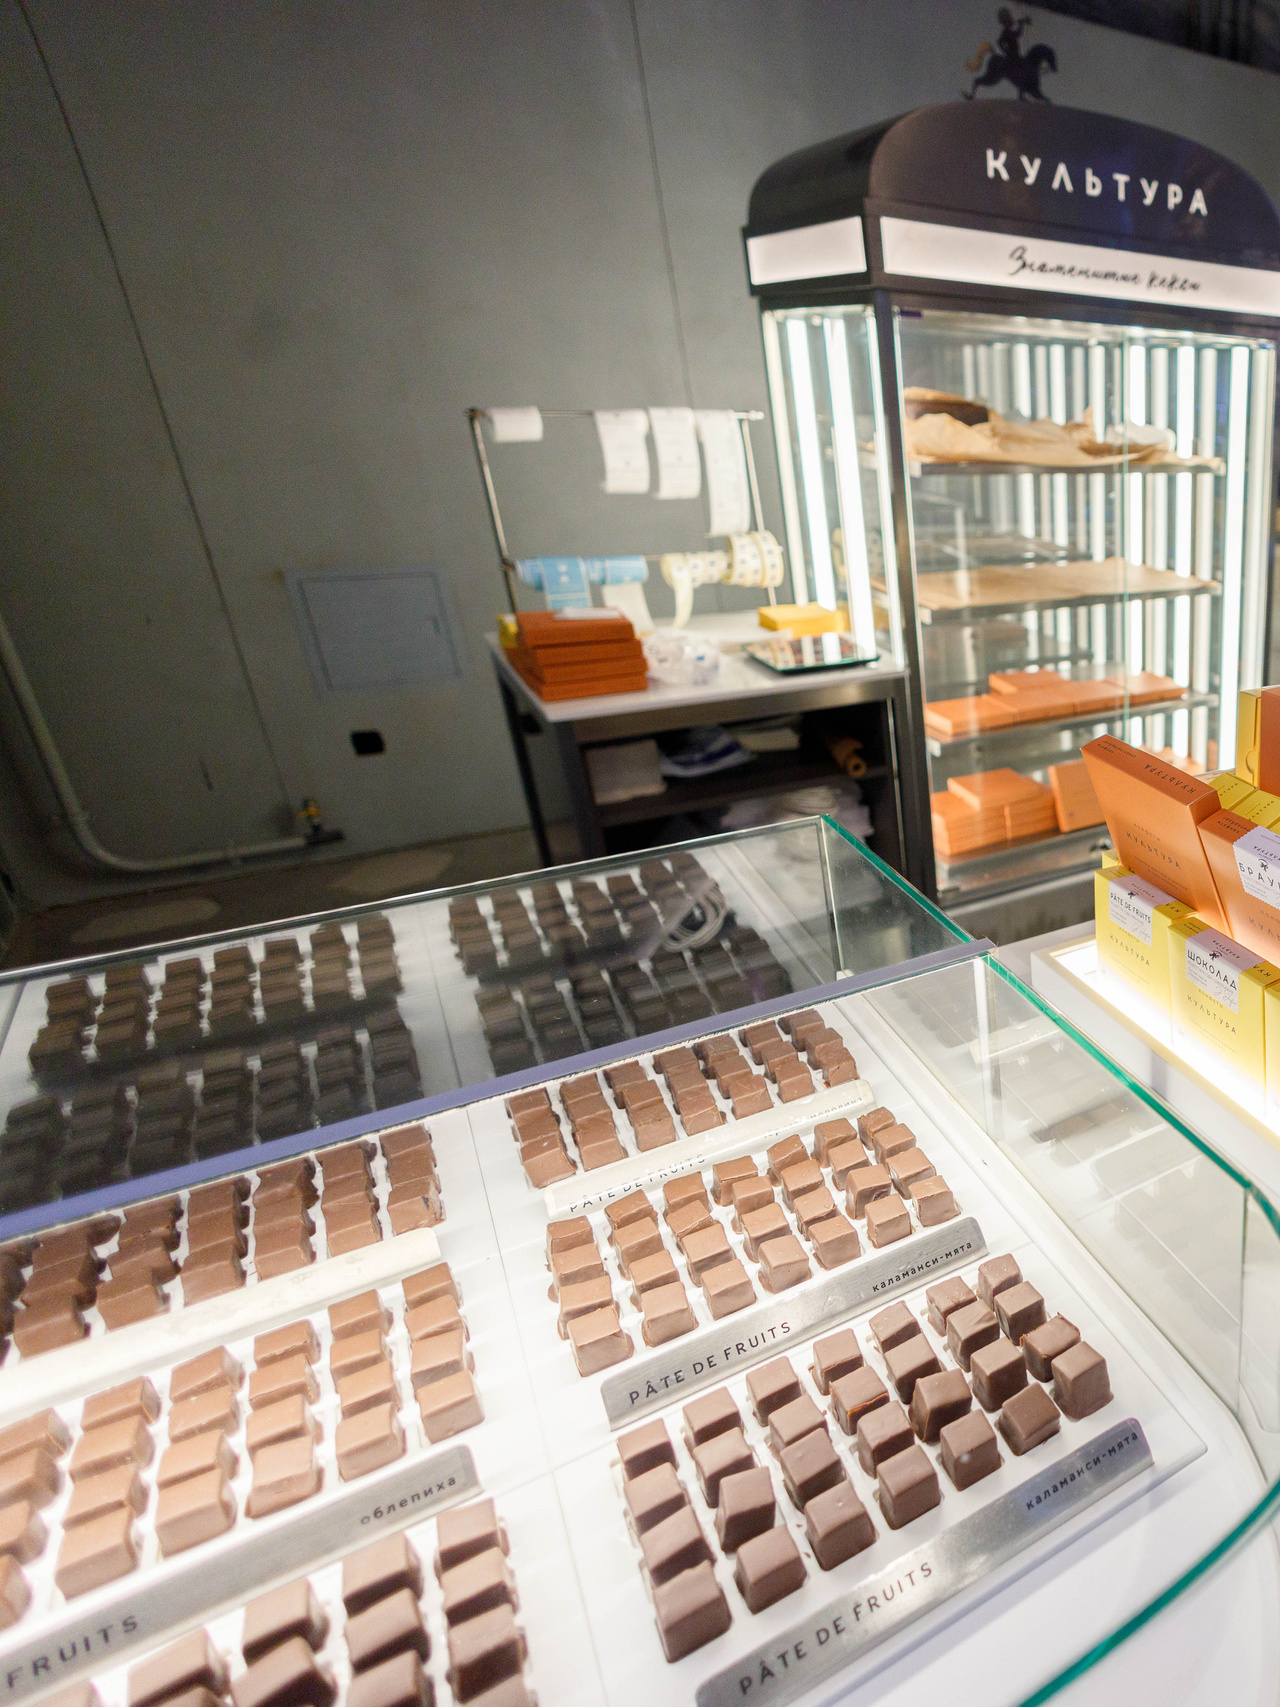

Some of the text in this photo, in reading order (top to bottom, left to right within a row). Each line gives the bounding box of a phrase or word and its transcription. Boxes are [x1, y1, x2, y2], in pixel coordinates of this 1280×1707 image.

[986, 149, 1208, 216] КУЛЬТУРА
[1144, 763, 1196, 794] КУЛЬТУРА
[1126, 831, 1182, 869] КУЛЬТУРА
[1124, 902, 1132, 912] DE
[1132, 905, 1151, 924] FRUITS
[1110, 934, 1150, 967] КУЛЬТУРА
[1187, 949, 1237, 991] ШОКОЛАД
[1187, 995, 1237, 1035] КУЛЬТУРА
[872, 1241, 973, 1293] каламанси-мята
[628, 1321, 791, 1405] PÂTE DE FRUITS
[1026, 1432, 1138, 1511] каламанси-мята
[360, 1476, 457, 1525] облепиха
[6, 1615, 138, 1689] FRUITS
[738, 1562, 933, 1696] PÂTE DE FRUITS
